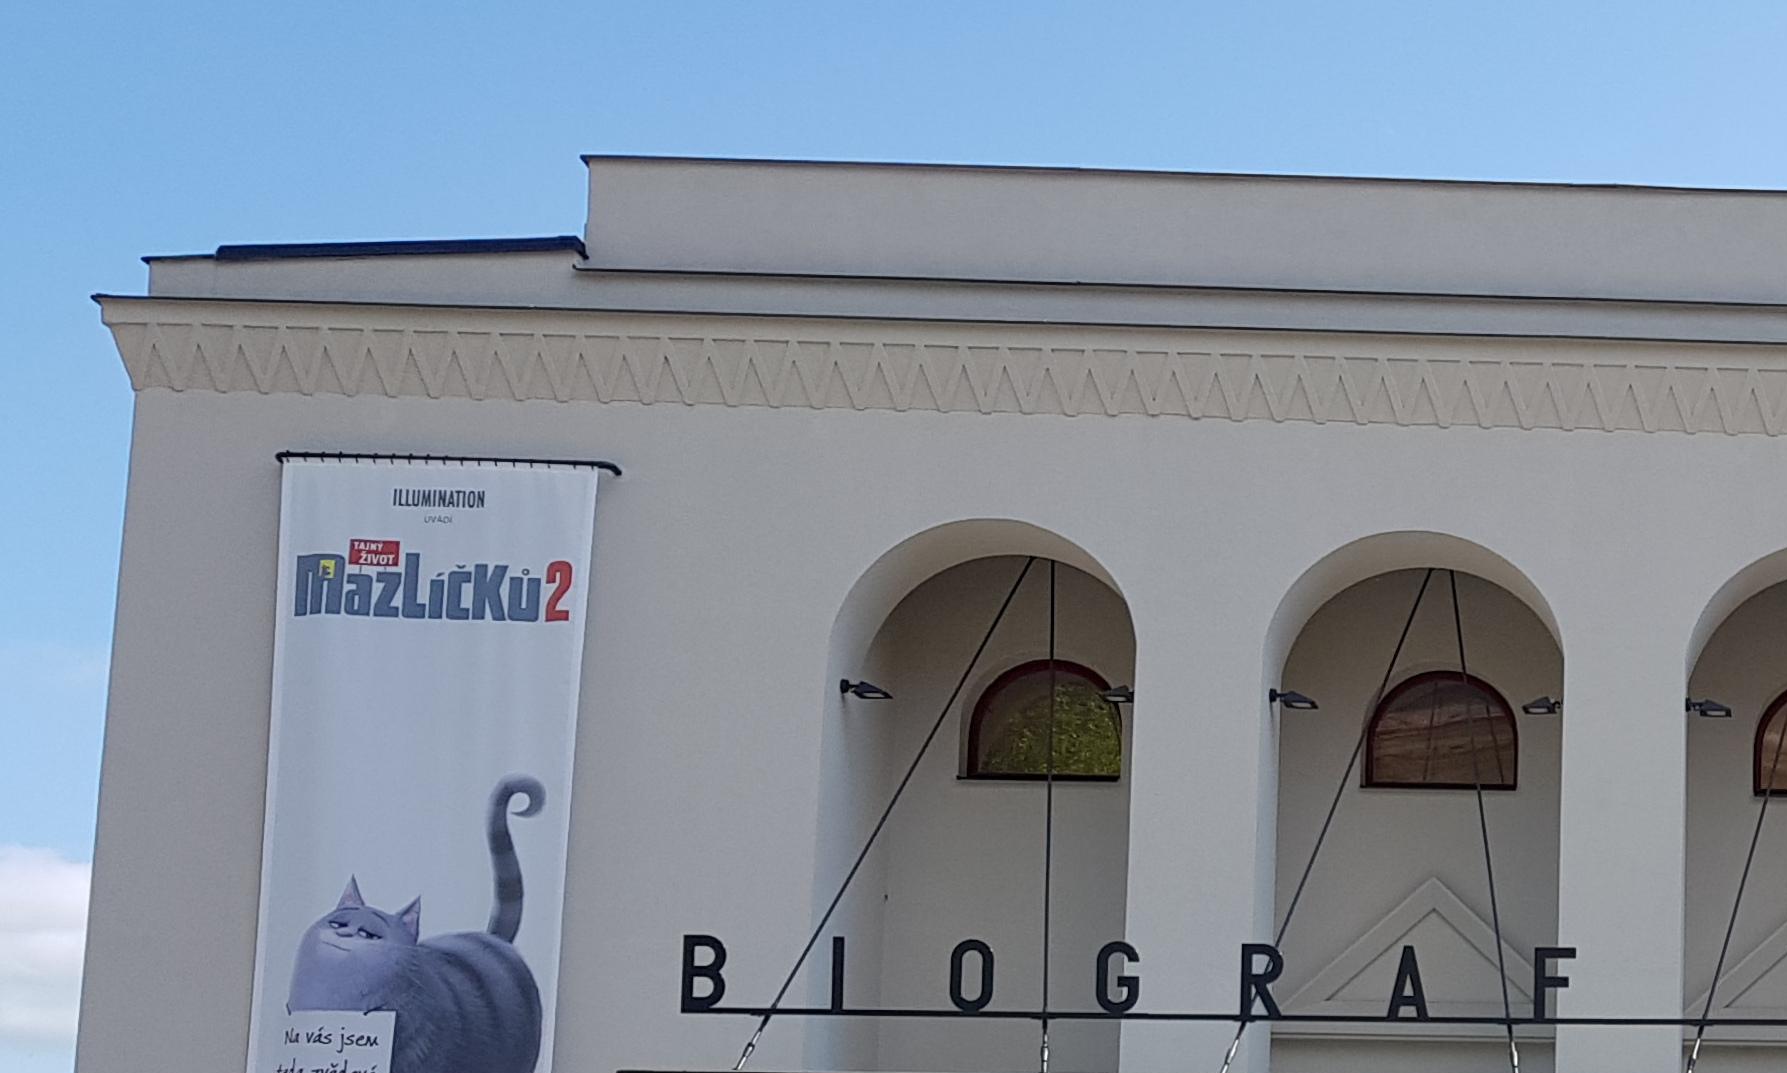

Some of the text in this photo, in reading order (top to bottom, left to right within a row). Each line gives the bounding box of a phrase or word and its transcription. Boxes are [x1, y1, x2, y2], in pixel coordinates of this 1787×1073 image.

[393, 489, 485, 508] ILLUMINATION
[354, 541, 383, 551] TAJNÝ
[359, 551, 395, 565] ŽIVOT
[545, 561, 573, 622] 2
[681, 934, 1577, 1020] BIOGRAF
[284, 1026, 379, 1053] Na vás jsem
